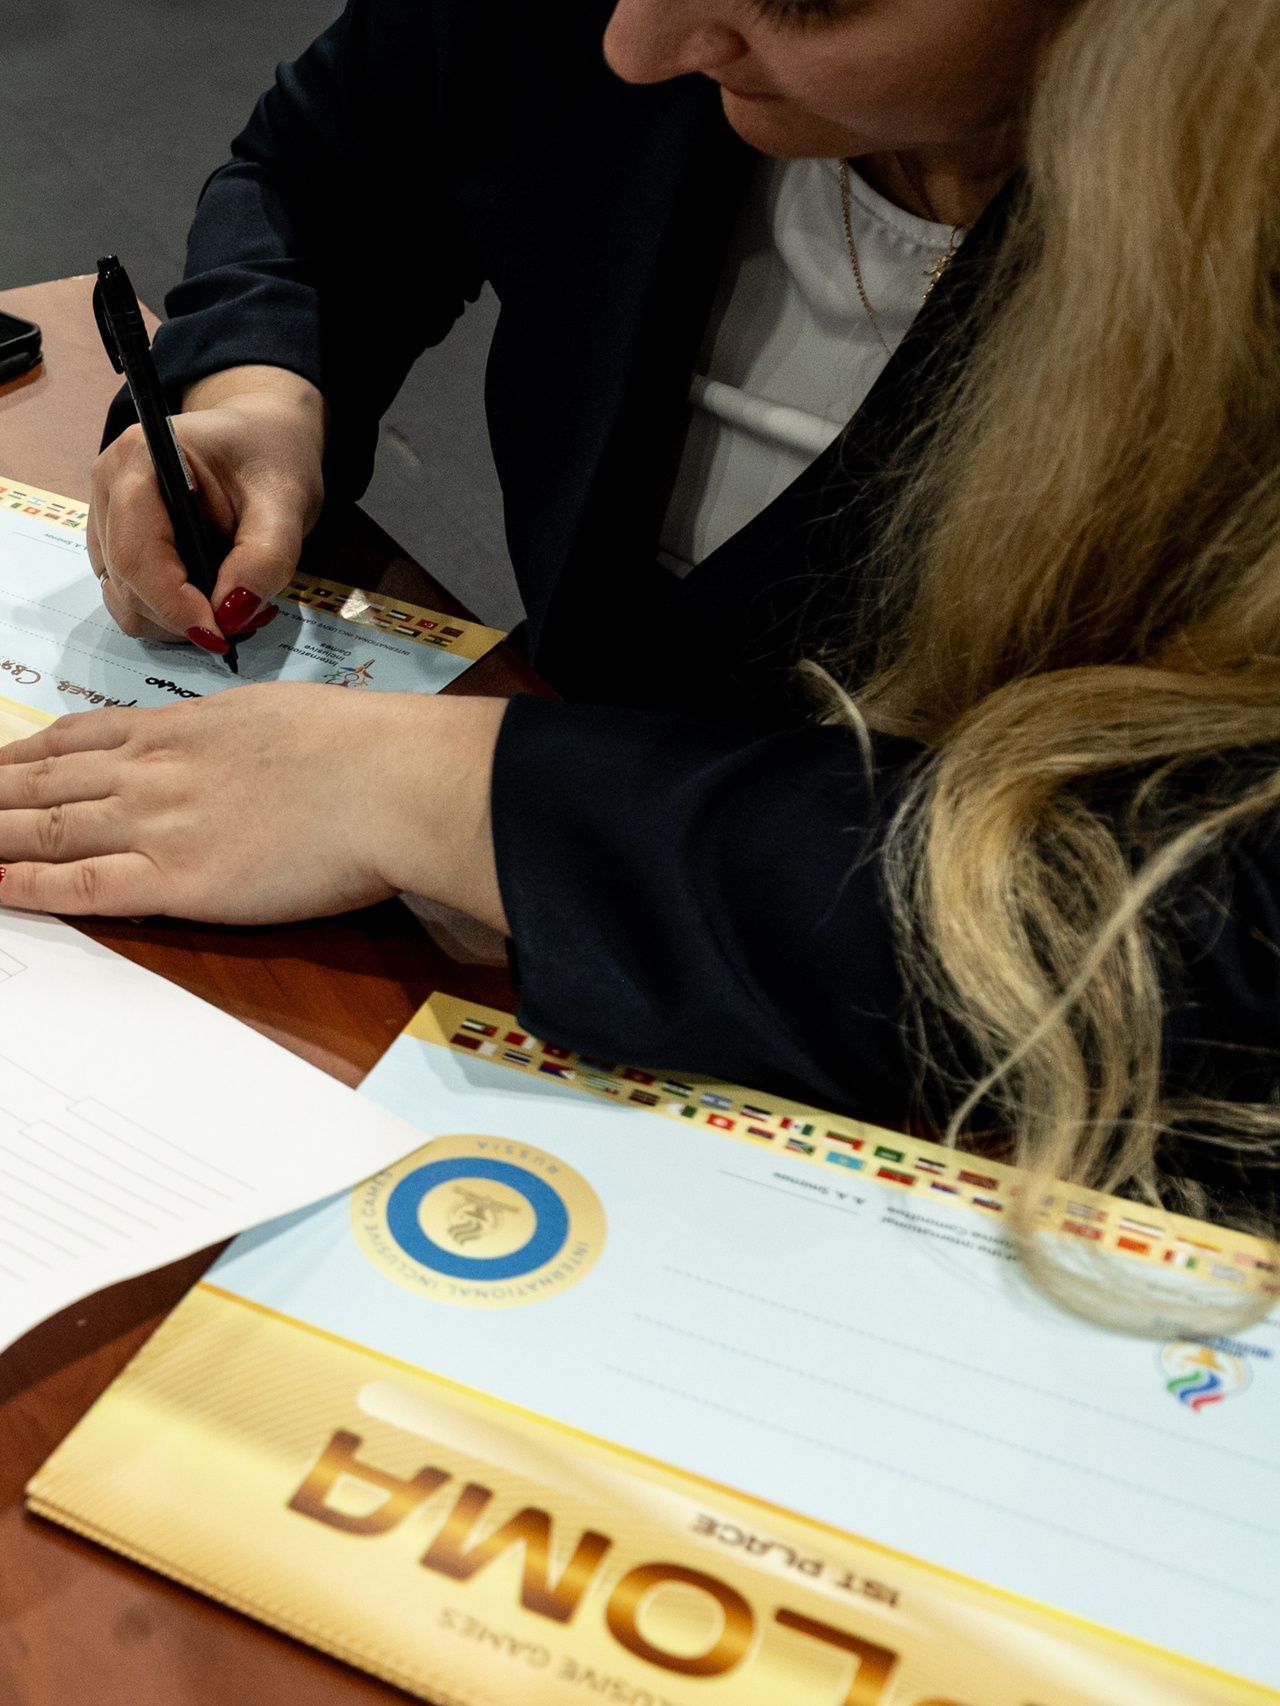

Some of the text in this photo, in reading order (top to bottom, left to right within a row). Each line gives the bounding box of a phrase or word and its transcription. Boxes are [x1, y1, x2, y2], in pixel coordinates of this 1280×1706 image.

[319, 623, 355, 640] INCLUSIVE
[354, 635, 411, 656] INTERNATIONAL
[278, 643, 339, 668] International
[304, 644, 346, 661] Inclusive
[320, 643, 352, 657] Games
[57, 680, 138, 708] АВЬЕВ
[477, 1140, 560, 1175] RUSSIA
[773, 1170, 830, 1195] Smirnov
[881, 1215, 975, 1249] International
[887, 1205, 967, 1235] Committee
[363, 1171, 590, 1299] INTERNATIONAL INCLUSIVE GAMES
[691, 1512, 824, 1581] PLACE
[437, 1607, 551, 1672] GAMES
